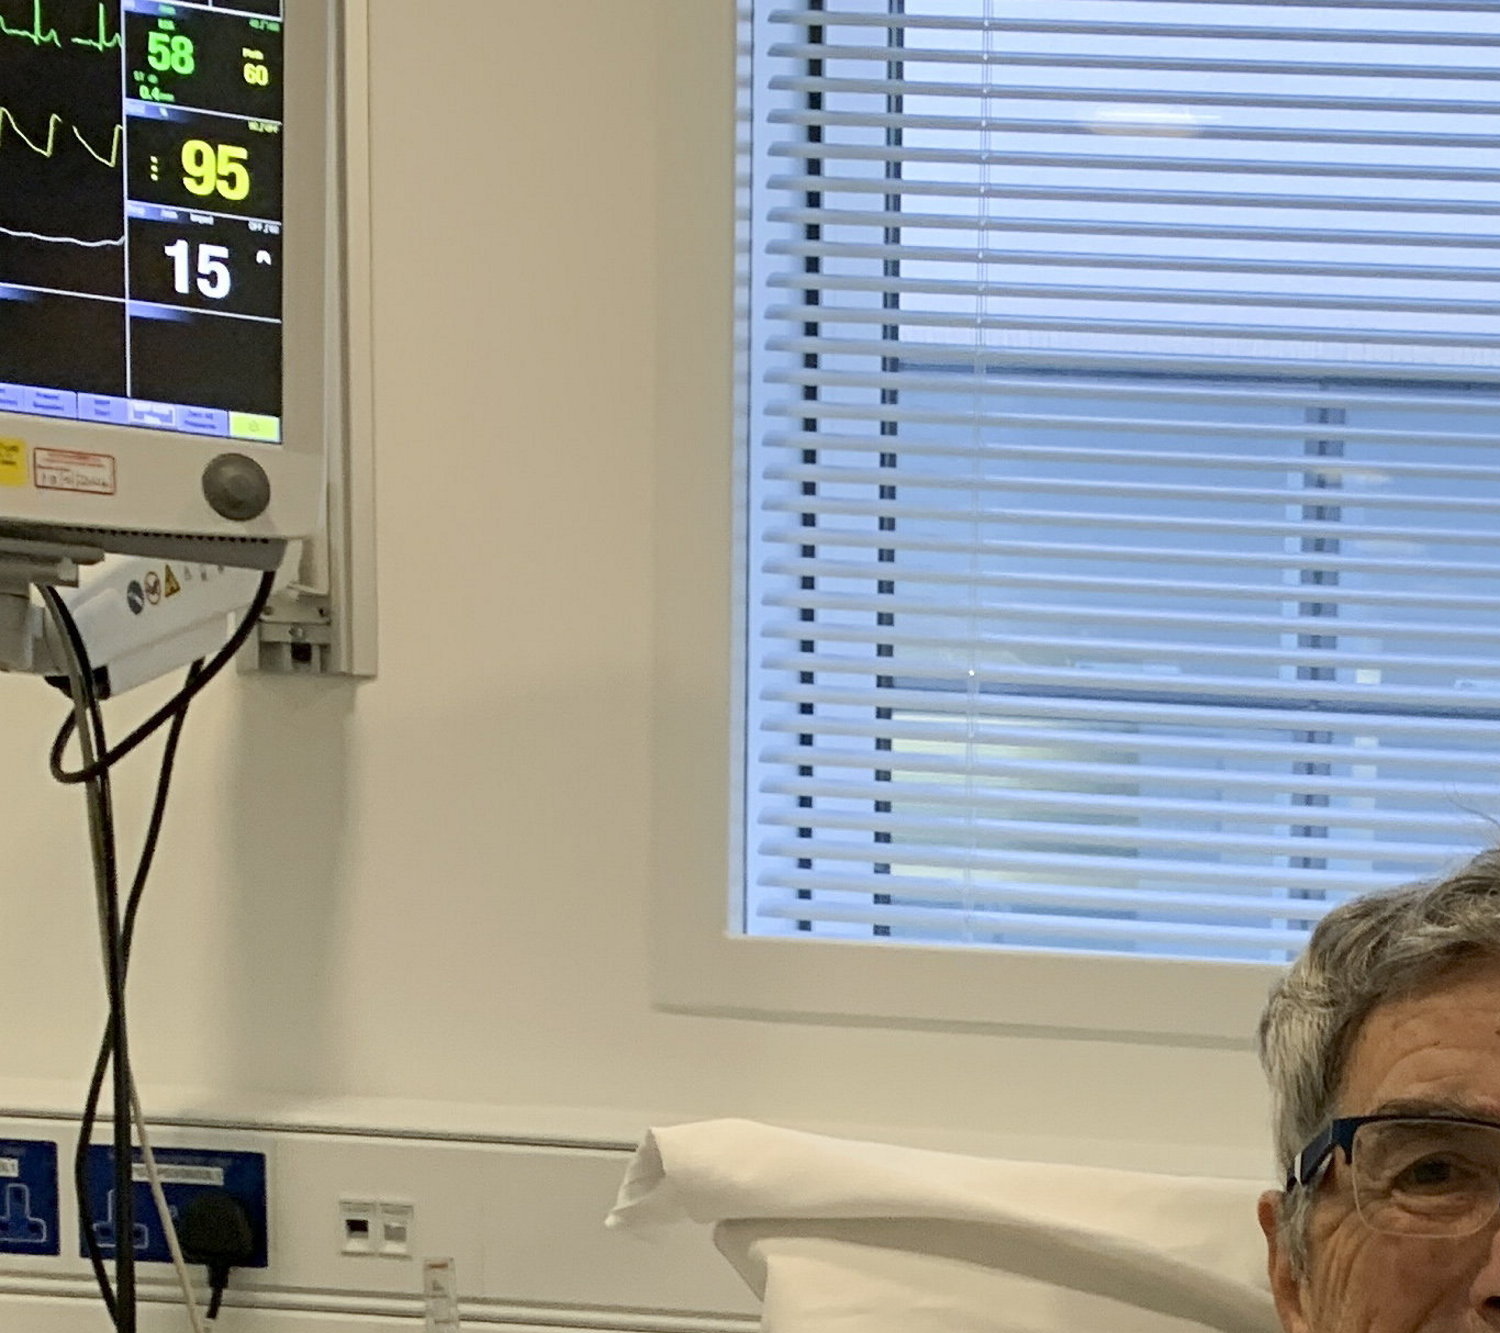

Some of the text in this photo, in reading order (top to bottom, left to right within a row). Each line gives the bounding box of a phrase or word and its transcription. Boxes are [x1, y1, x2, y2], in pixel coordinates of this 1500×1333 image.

[148, 31, 195, 75] 58
[243, 62, 269, 86] 60
[181, 139, 250, 201] 95
[164, 239, 231, 299] 15
